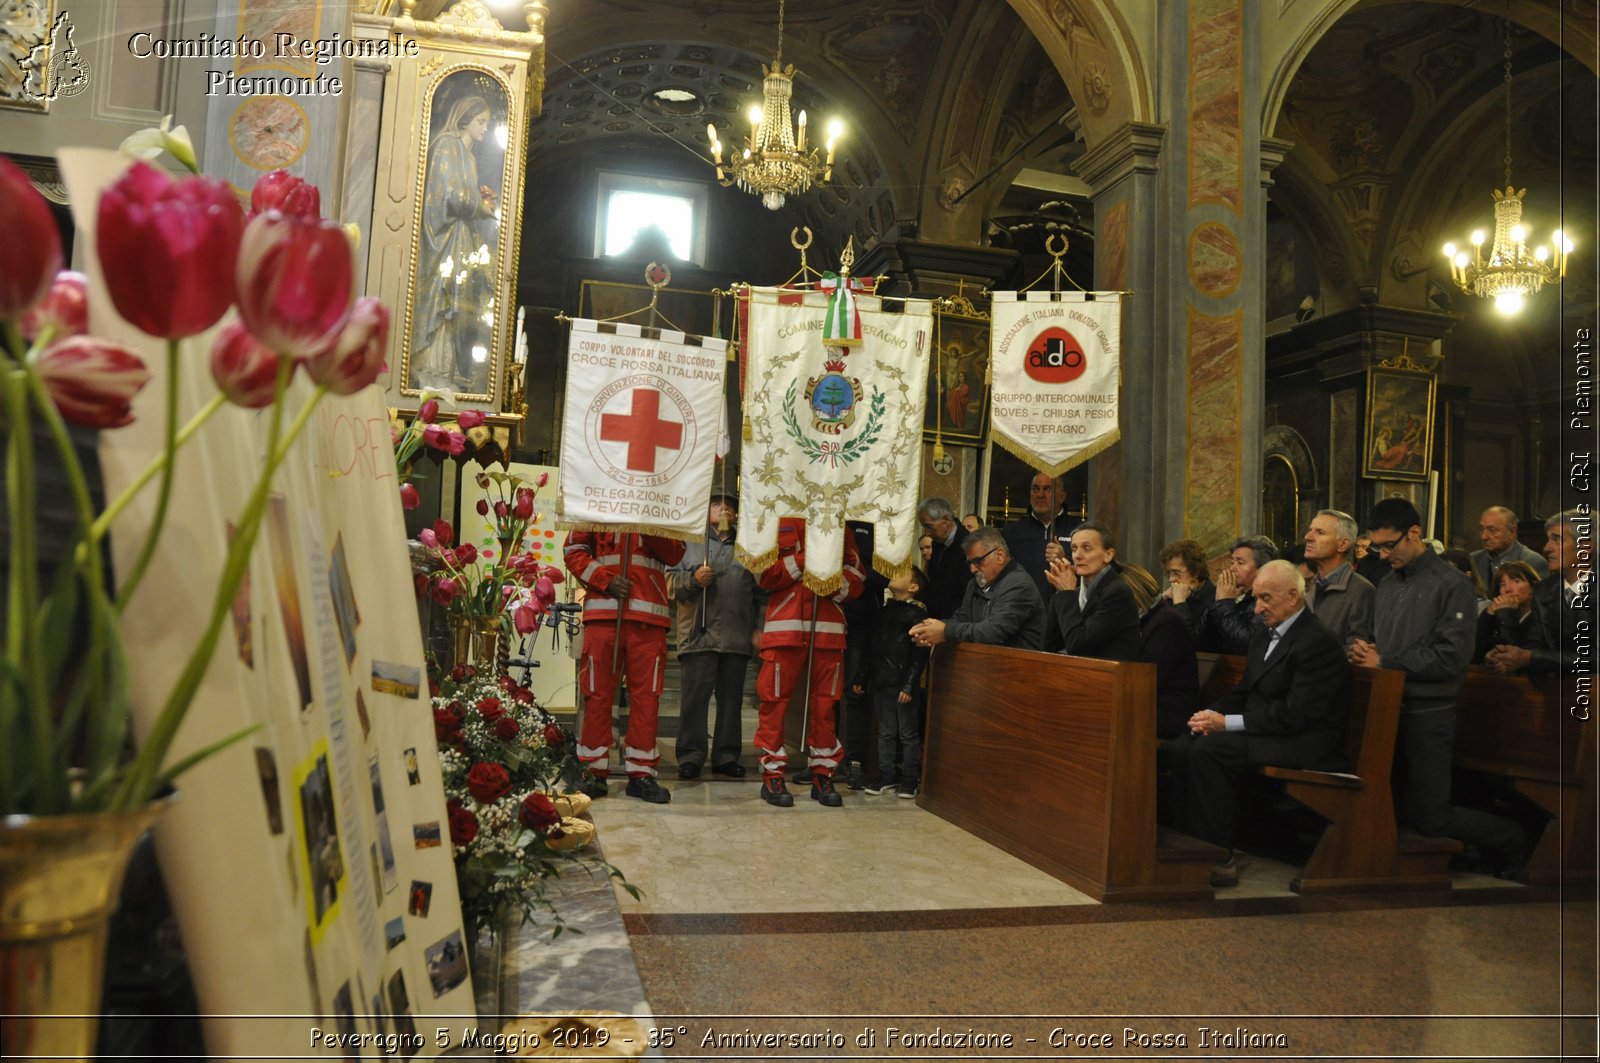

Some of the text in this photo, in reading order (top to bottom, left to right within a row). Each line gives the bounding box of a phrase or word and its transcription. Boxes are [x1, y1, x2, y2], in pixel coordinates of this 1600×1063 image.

[778, 320, 824, 339] COMUNE
[999, 308, 1113, 355] ASSOCIAZIONE ITALIANA DONATORI ORGANI
[579, 340, 716, 369] CORPO VOLONTARI DEL SOCCORSO
[1029, 338, 1082, 368] aido
[571, 352, 721, 382] CROCE ROSSA ITALIANA
[590, 375, 694, 426] CONVENZIONE DI GINEVRA
[993, 393, 1115, 404] GRUPPO INTERCOMUNALE
[994, 408, 1029, 418] BOVES
[1043, 408, 1081, 419] CHIUSA
[1085, 409, 1115, 419] PESIO
[1021, 424, 1087, 435] PEVERAGNO
[584, 486, 688, 506] DELEGAZIONE DI
[587, 500, 682, 521] PEVERAGNO
